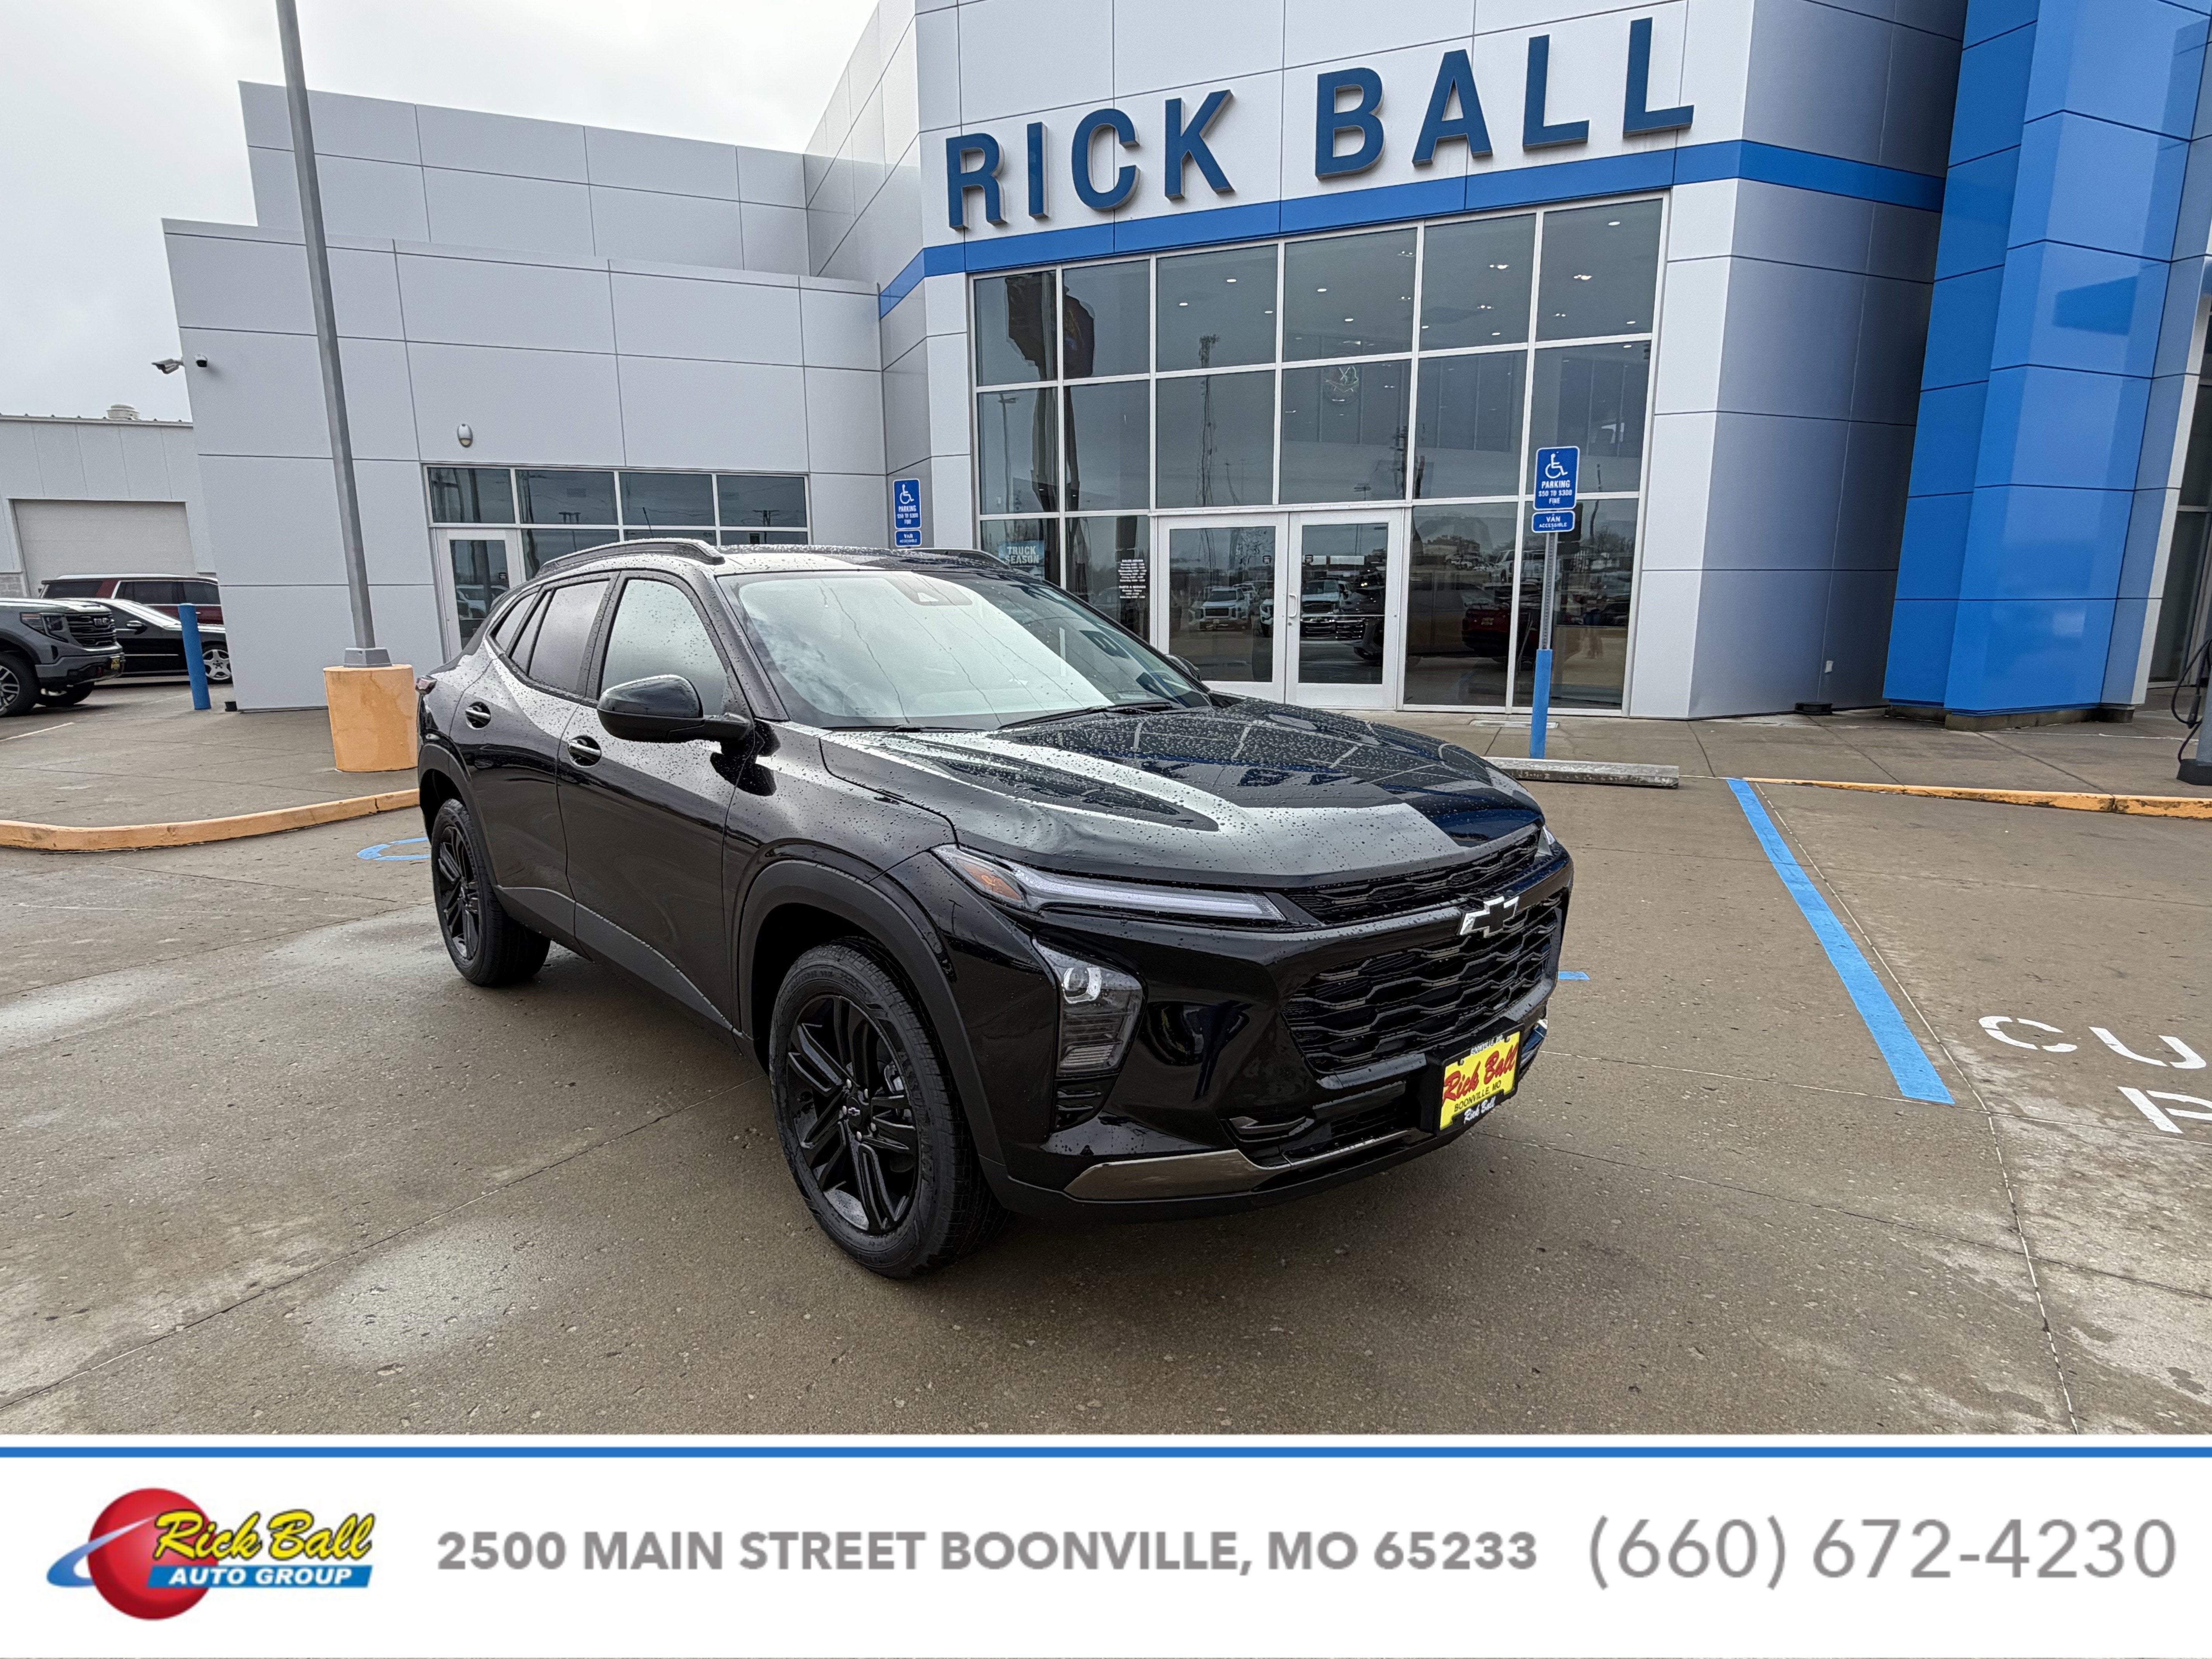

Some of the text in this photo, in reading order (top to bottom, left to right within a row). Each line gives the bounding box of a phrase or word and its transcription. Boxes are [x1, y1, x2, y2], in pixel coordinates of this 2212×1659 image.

[946, 17, 1694, 230] RICK BALL
[1541, 479, 1570, 489] PARKING
[1005, 554, 1040, 564] SEASON
[1007, 545, 1037, 555] TRUCK
[1442, 1042, 1519, 1104] Rick Ball
[1454, 1080, 1502, 1112] BOONVILLE MO
